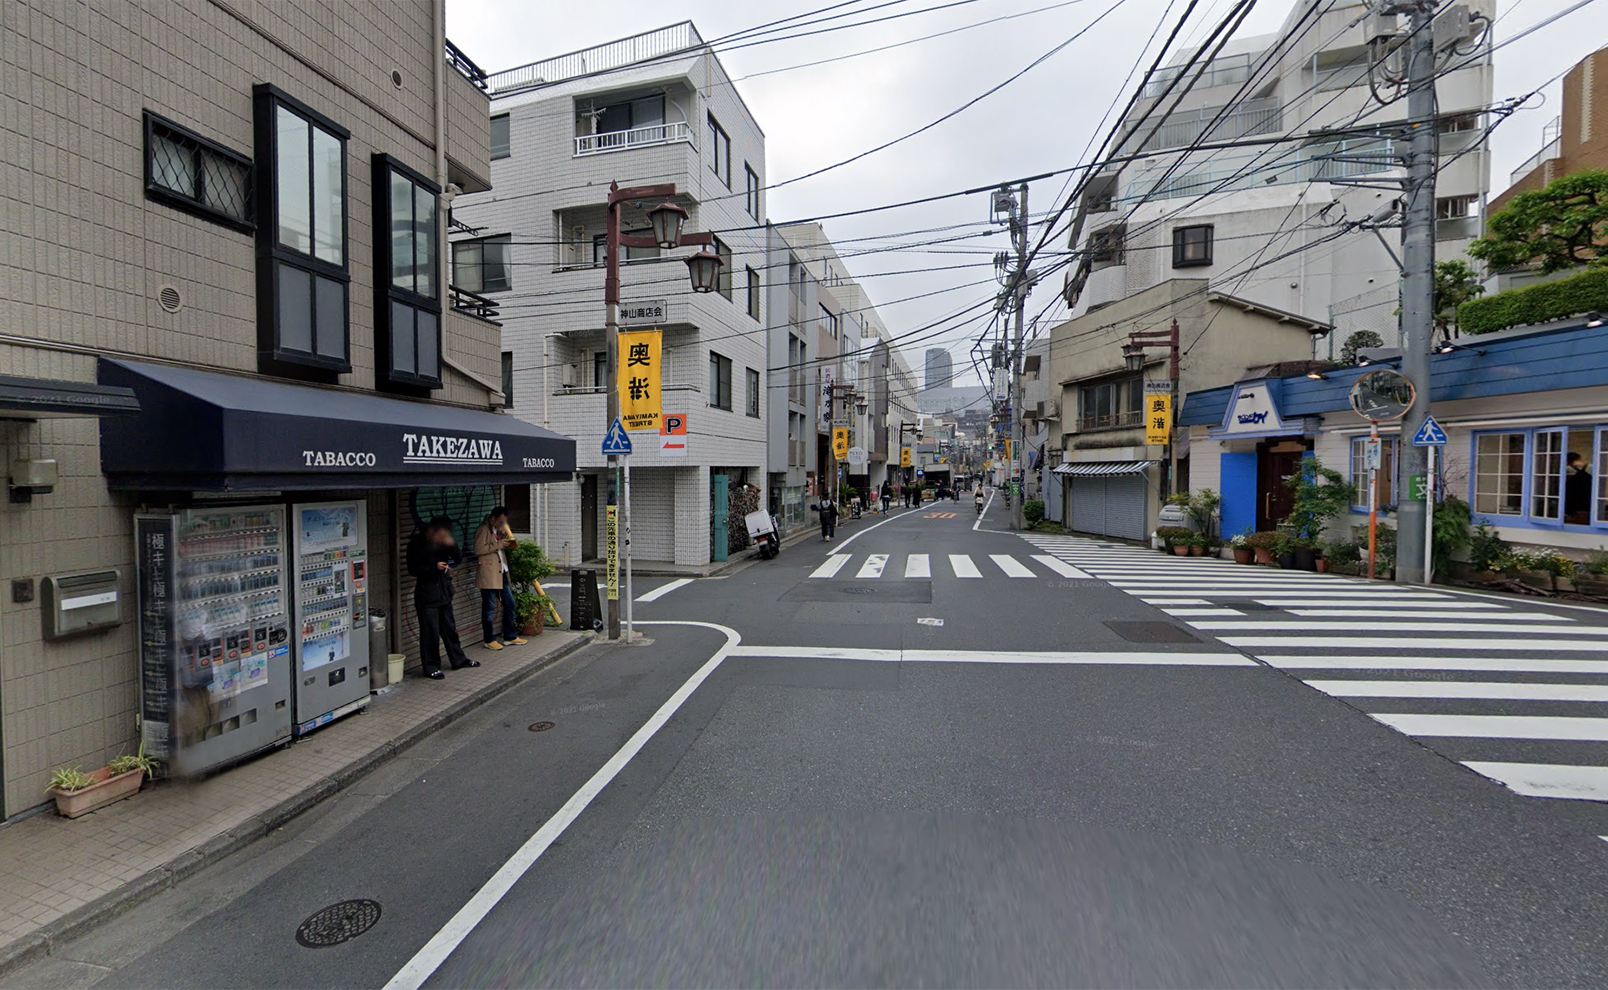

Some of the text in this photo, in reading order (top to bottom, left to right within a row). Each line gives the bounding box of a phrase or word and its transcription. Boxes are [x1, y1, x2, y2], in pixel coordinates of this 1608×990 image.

[620, 307, 662, 319] 神山商店会
[1152, 400, 1166, 429] 奥渋
[666, 417, 682, 434] P
[403, 433, 503, 460] TAKEZAWA
[303, 450, 376, 466] TABACCO
[522, 458, 555, 468] TABACCO
